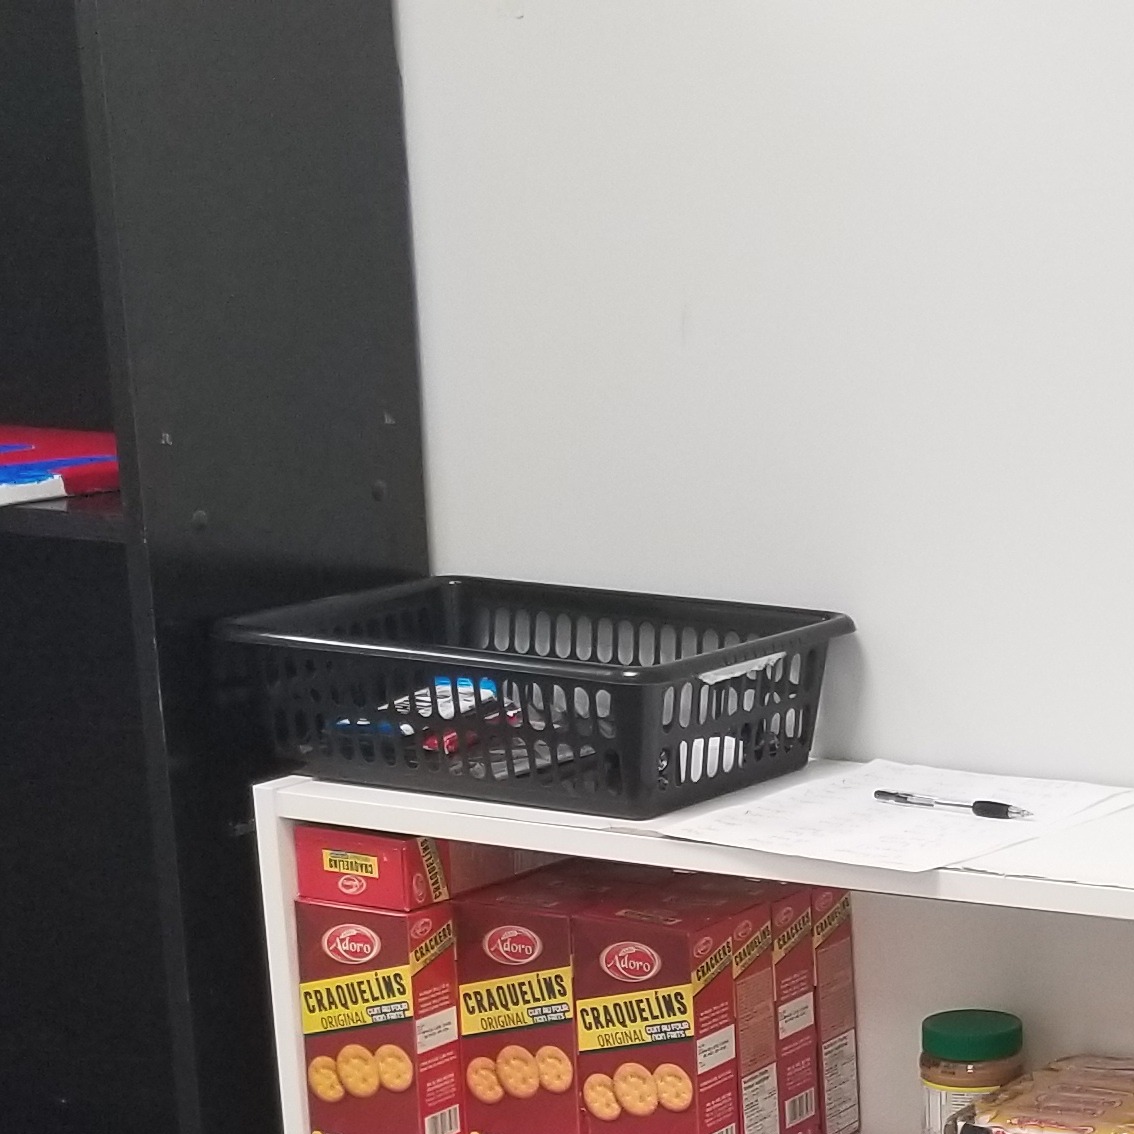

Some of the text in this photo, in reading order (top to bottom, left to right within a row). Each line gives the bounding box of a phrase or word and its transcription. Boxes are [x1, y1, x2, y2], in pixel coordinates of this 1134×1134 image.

[329, 935, 371, 955] Adoro
[413, 922, 452, 962] CRACKERS
[489, 936, 533, 956] Adoro
[606, 953, 651, 973] Adoro
[695, 940, 732, 982] CRACKERS
[320, 1010, 367, 1029] ORIGINAL
[480, 1010, 528, 1030] ORIGINAL
[597, 1028, 646, 1048] ORIGINAL
